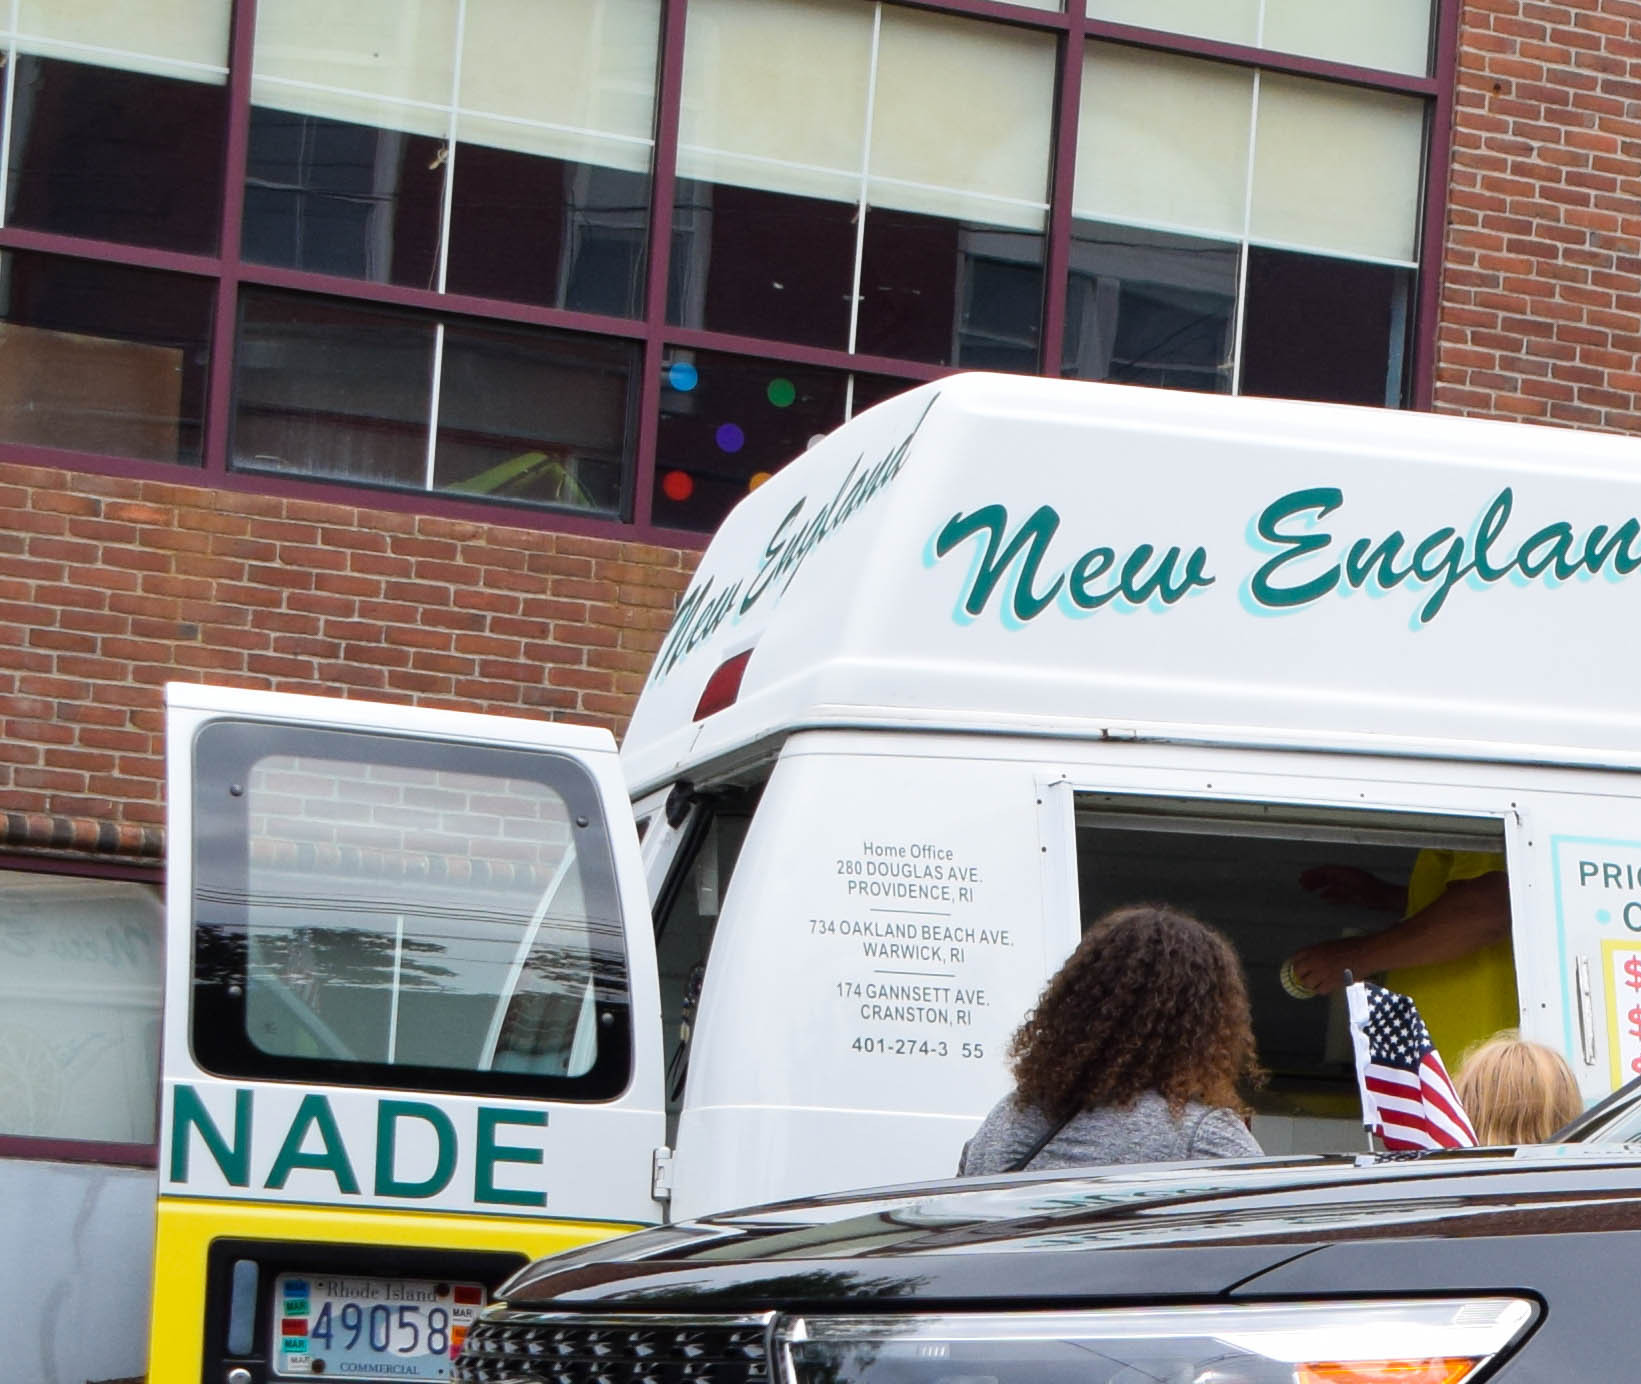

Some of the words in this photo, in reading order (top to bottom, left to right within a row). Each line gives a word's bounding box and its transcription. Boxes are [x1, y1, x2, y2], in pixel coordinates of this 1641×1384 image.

[655, 575, 743, 680] New
[739, 391, 942, 616] England
[926, 504, 1216, 627] New
[863, 841, 906, 859] Home
[910, 844, 954, 861] Office
[836, 860, 862, 876] 280
[866, 861, 944, 880] DOUGLAS
[947, 867, 983, 883] AVE.
[848, 880, 955, 903] PROVIDENCE,
[958, 887, 974, 903] RI
[809, 920, 835, 936] 734
[839, 920, 918, 940] OAKLAND
[921, 925, 975, 944] BEACH
[979, 929, 1014, 947] AVE.
[863, 942, 946, 965] WARWICK,
[950, 948, 965, 963] RI
[836, 982, 862, 998] 174
[866, 983, 951, 1003] GANNSETT
[954, 989, 990, 1007] AVE.
[860, 1004, 953, 1027] CRANSTON,
[956, 1010, 972, 1026] RI
[169, 1083, 550, 1207] NADE
[327, 1279, 379, 1298] Rhode
[311, 1301, 448, 1355] 49058
[340, 1362, 420, 1376] COMMERCIAL
